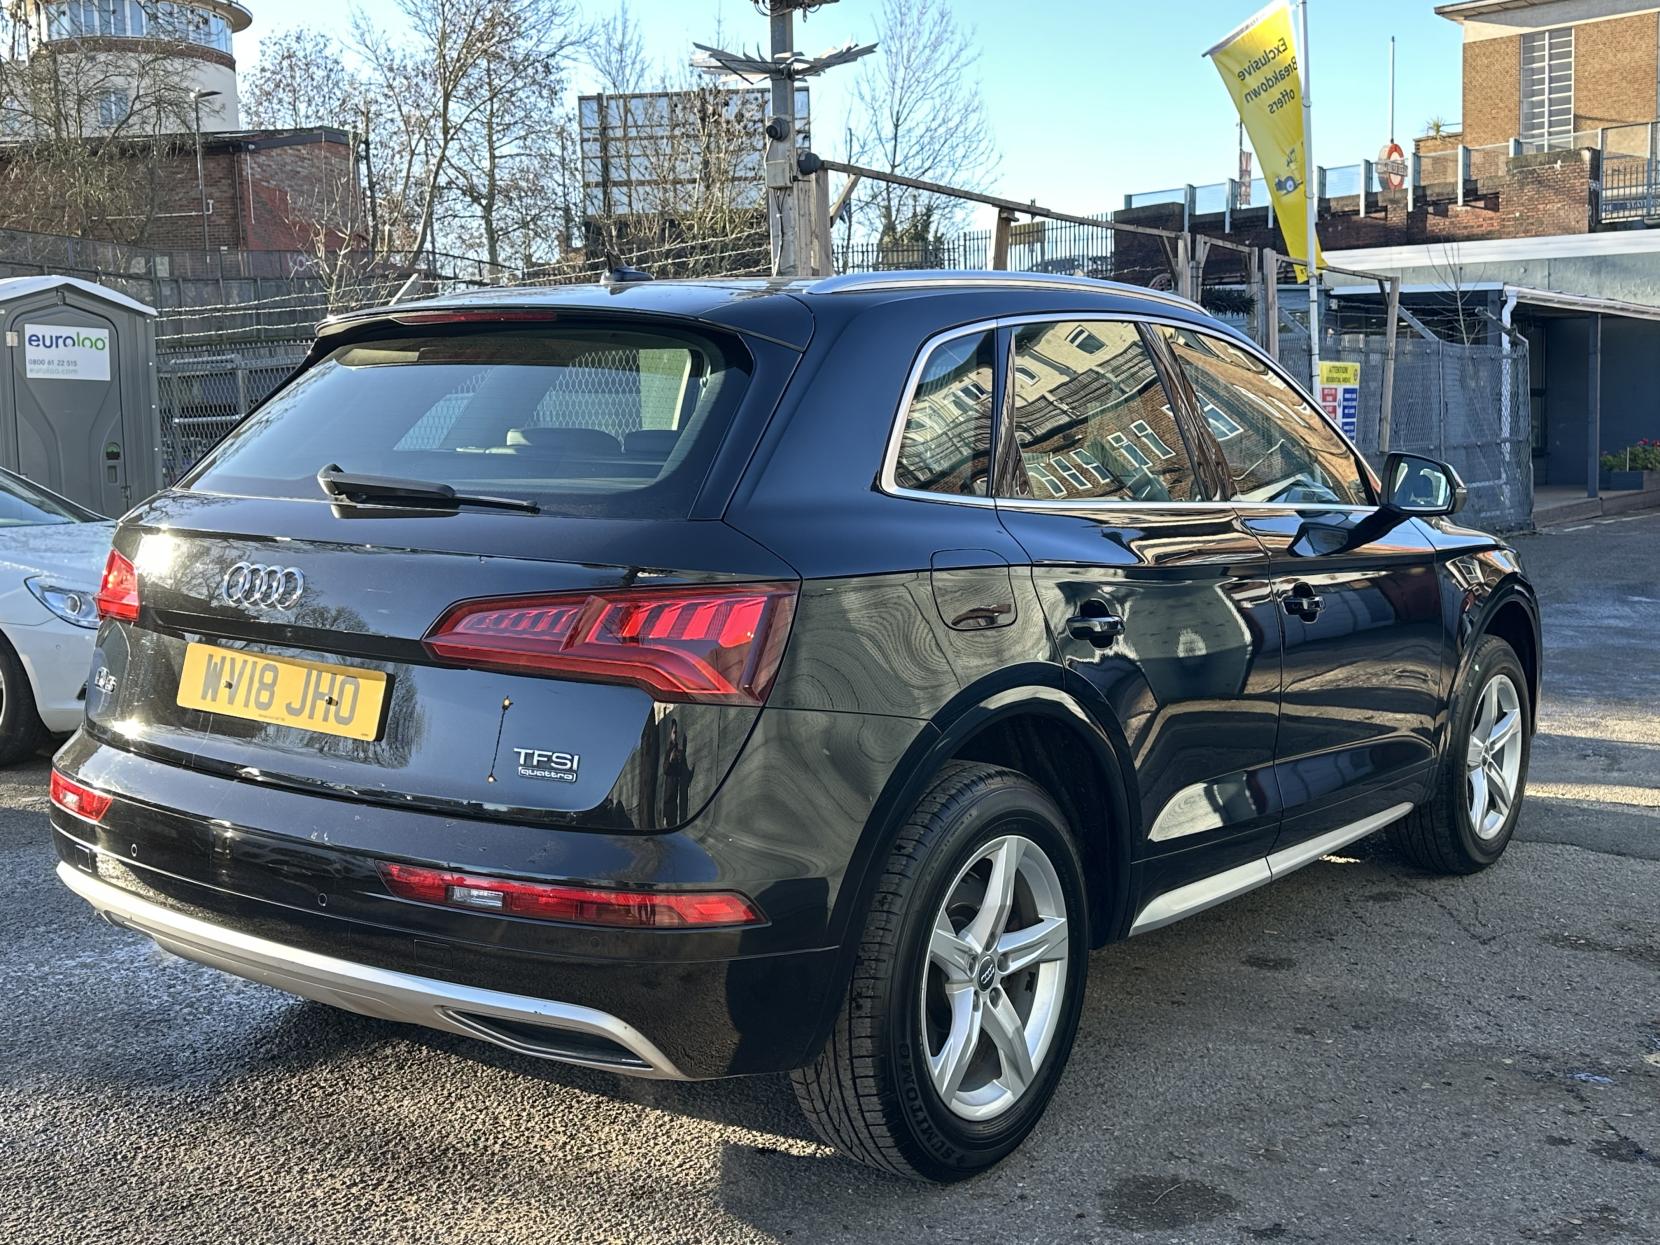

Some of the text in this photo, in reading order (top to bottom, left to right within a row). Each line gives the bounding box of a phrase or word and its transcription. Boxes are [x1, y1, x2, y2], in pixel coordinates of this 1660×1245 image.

[27, 331, 106, 351] euroloo
[201, 653, 361, 726] WV18 JHO
[513, 747, 580, 771] TFSI
[520, 768, 574, 780] quattro
